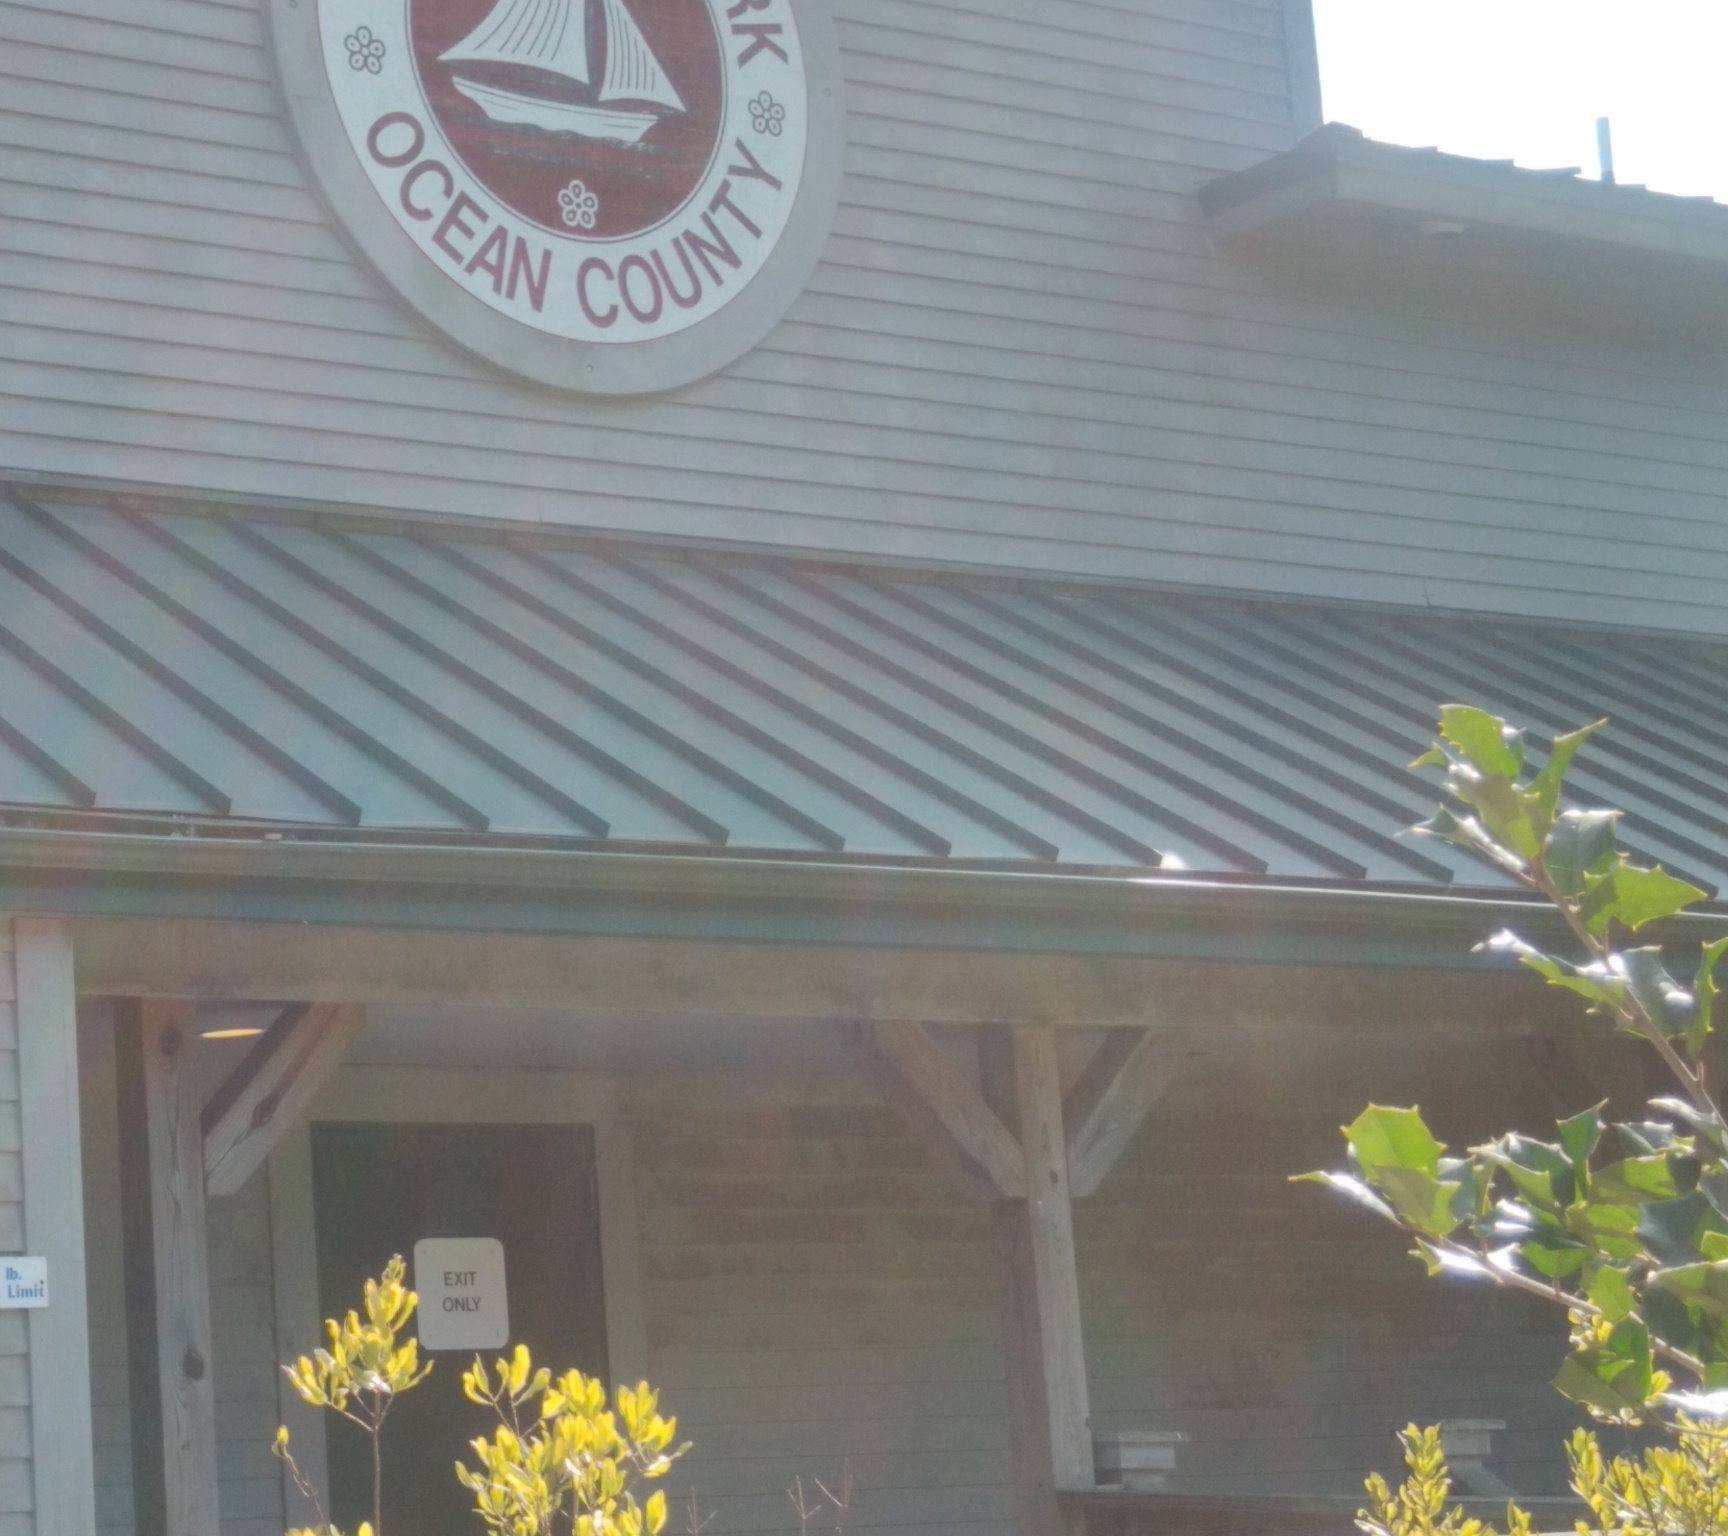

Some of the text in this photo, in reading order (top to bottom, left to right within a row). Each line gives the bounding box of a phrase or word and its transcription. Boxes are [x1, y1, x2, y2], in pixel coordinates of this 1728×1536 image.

[366, 110, 784, 330] OCEAN COUNTY
[6, 1267, 23, 1281] lb.
[443, 1271, 477, 1287] EXIT
[8, 1284, 45, 1299] Limit
[442, 1296, 482, 1313] ONLY
